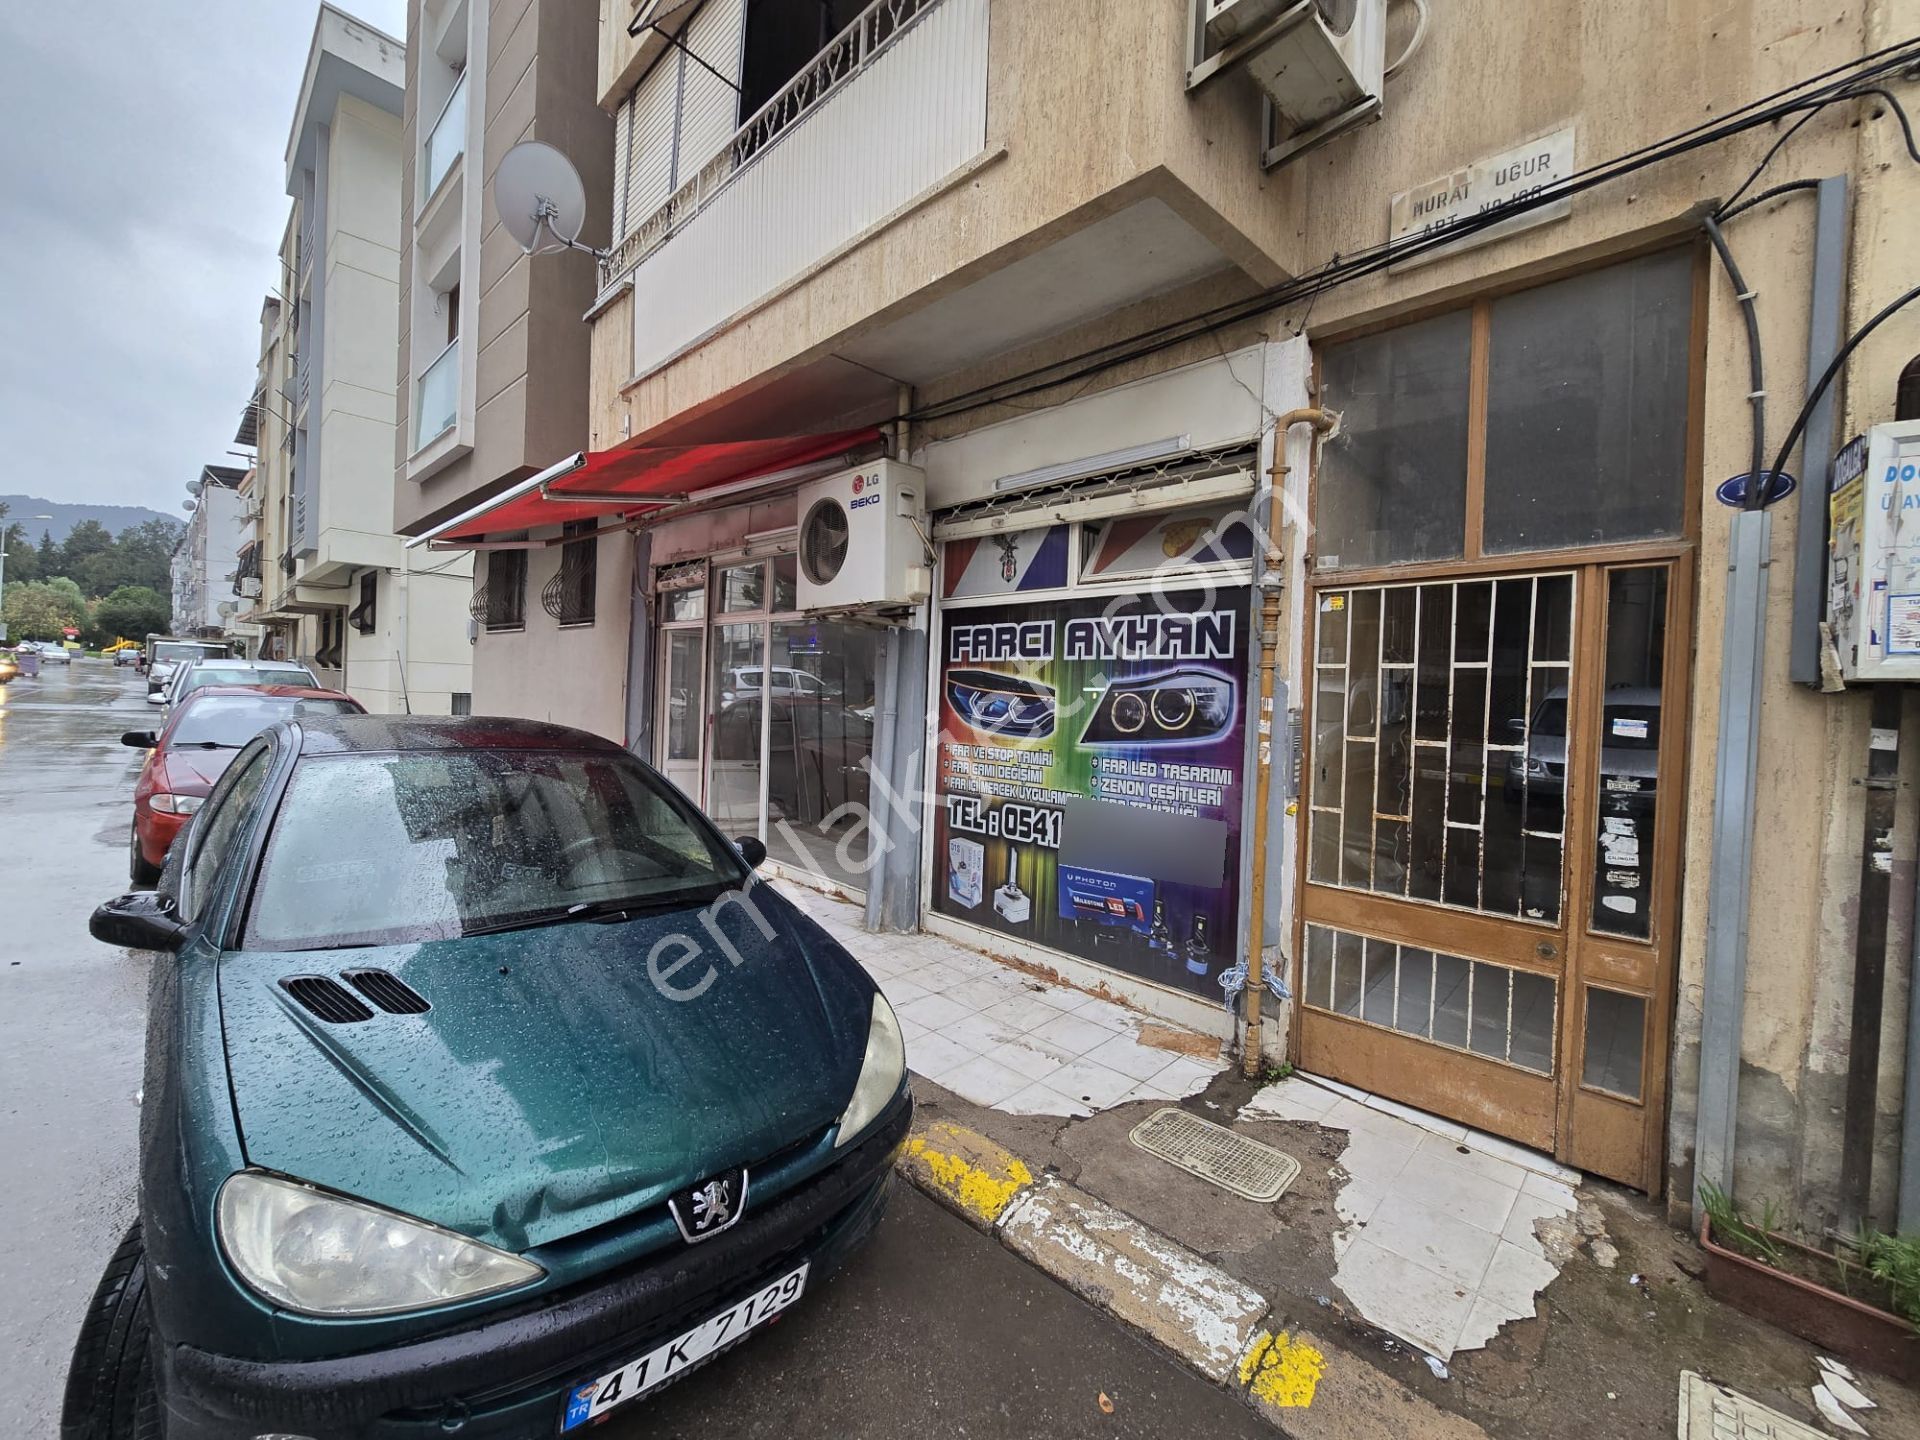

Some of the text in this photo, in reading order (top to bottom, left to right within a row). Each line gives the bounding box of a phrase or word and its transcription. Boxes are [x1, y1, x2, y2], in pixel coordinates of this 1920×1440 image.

[1412, 152, 1551, 217] MURAT UĞUR
[866, 474, 879, 487] LG
[1883, 464, 1920, 483] DO
[850, 494, 880, 510] BEKO
[1063, 610, 1236, 662] AYHAN
[972, 746, 985, 759] VE
[987, 747, 1014, 762] STOP
[951, 760, 970, 774] FAR
[1102, 757, 1233, 785] FAR LED TASARIMI
[950, 776, 966, 791] FAR
[1100, 777, 1145, 797] ZENON
[1148, 782, 1222, 806] ÇEŞİTLERİ
[1002, 803, 1062, 848] 0541
[570, 1272, 803, 1419] TR 41 K 7129
